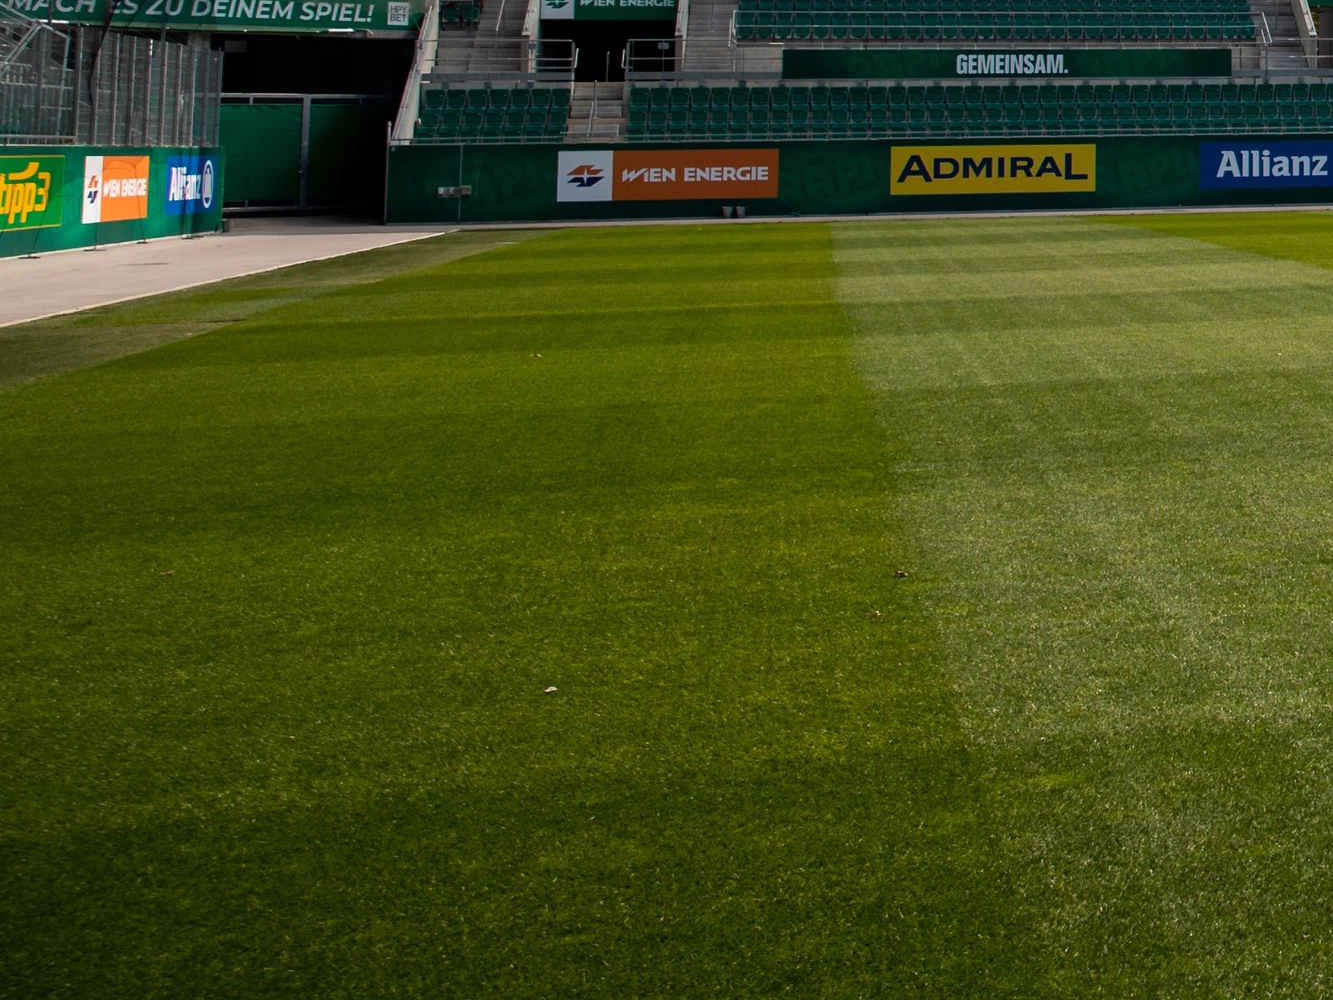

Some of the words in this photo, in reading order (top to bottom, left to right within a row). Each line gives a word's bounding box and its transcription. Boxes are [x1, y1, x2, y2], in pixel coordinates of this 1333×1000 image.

[299, 1, 375, 23] SPIEL!
[390, 13, 407, 22] BET
[956, 54, 1069, 75] GEMEINSAM.
[621, 167, 676, 183] WIEN
[683, 165, 770, 182] ENERGIE
[896, 152, 1089, 184] ADMIRAL
[1215, 149, 1329, 179] Allianz
[103, 179, 120, 198] WIEN
[121, 177, 148, 197] ENERGIE
[168, 166, 202, 203] Allianz
